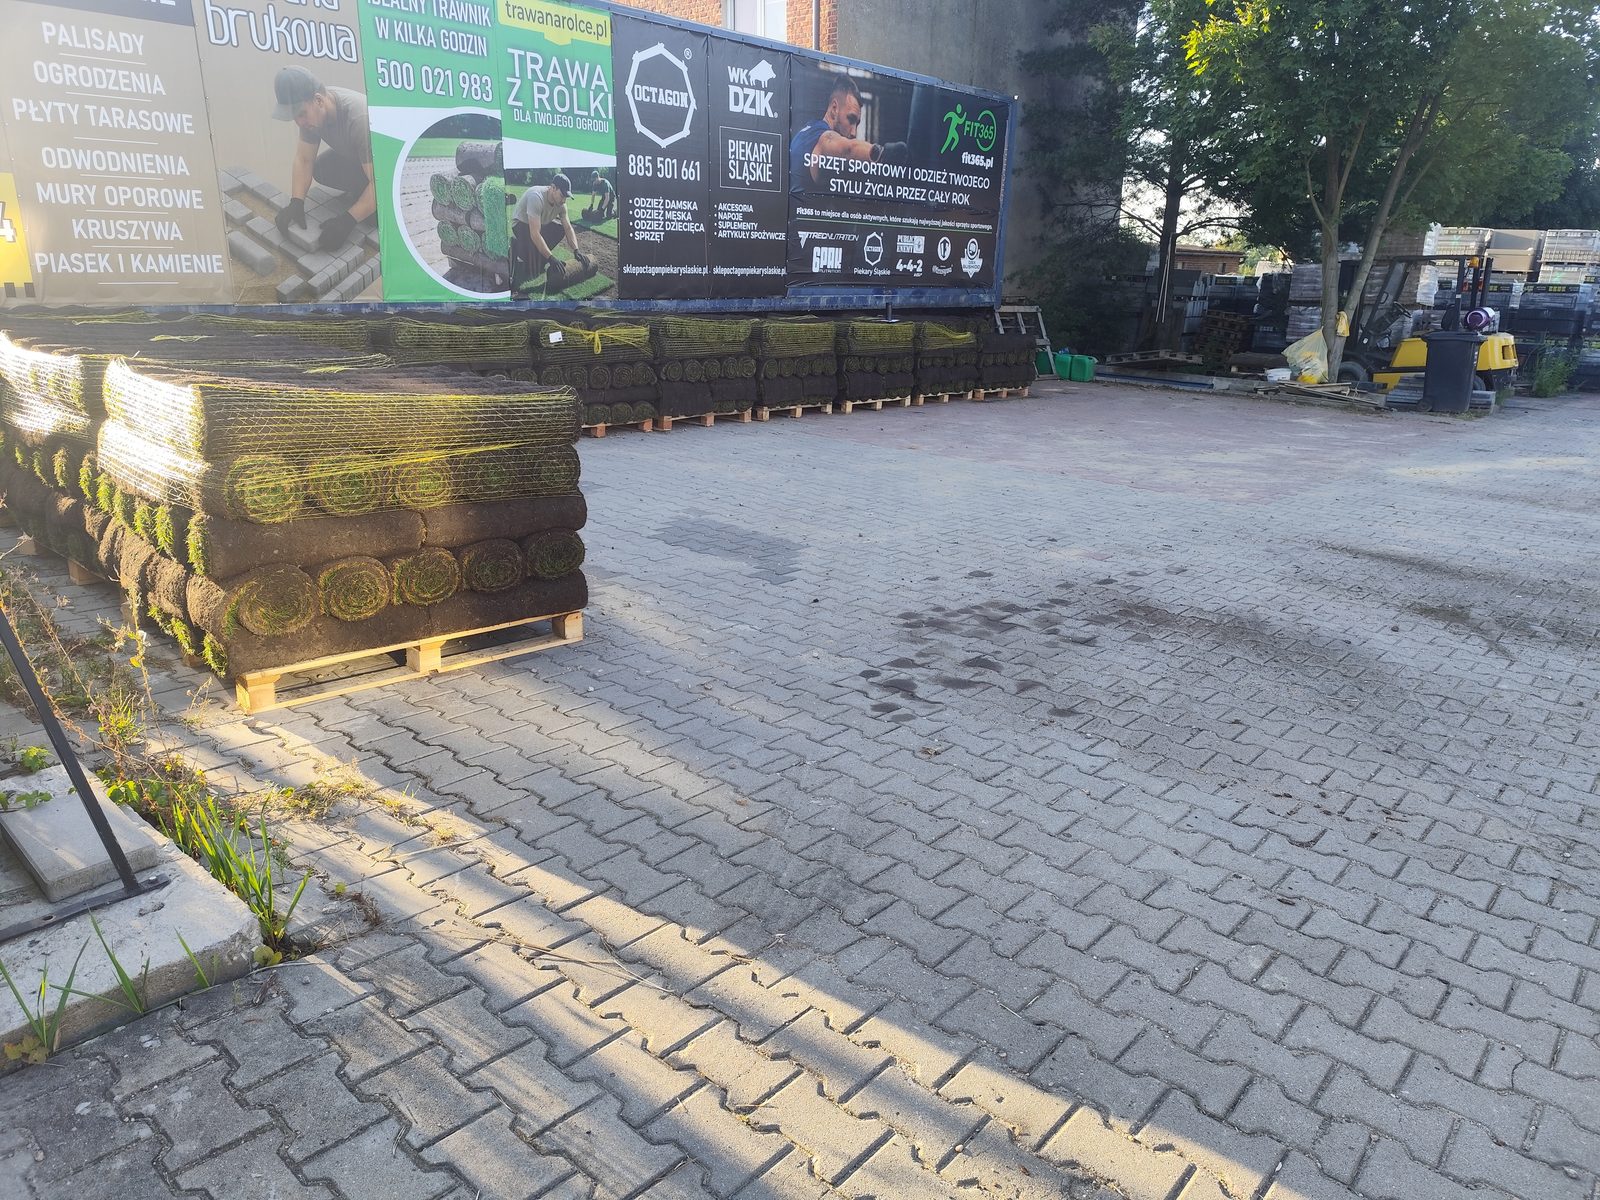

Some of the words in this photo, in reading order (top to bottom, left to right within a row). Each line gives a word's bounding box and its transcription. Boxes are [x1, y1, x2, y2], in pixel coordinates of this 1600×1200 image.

[432, 0, 491, 27] TRAWNIK
[505, 1, 607, 40] trawanarolce.pl
[41, 21, 144, 56] PALISADY
[203, 2, 358, 63] brukowa
[375, 16, 389, 40] W
[394, 20, 437, 48] KILKA
[440, 29, 488, 57] GODZIN
[33, 60, 167, 96] OGRODZENIA
[376, 57, 415, 91] 500
[420, 64, 454, 98] 021
[458, 70, 493, 103] 983
[506, 47, 609, 92] TRAWA
[728, 66, 749, 85] WK
[506, 77, 523, 106] Z
[533, 82, 613, 120] ROLKI
[634, 84, 689, 108] OCTAGON
[728, 84, 774, 118] DZIK
[12, 97, 79, 125] PŁYTY
[84, 104, 195, 135] TARASOWE
[513, 108, 532, 123] DLA
[534, 111, 574, 128] TWOJEGO
[576, 117, 609, 133] OGRODU
[964, 120, 994, 140] FIT365
[41, 147, 190, 176] ODWODNIENIA
[728, 139, 773, 163] PIEKARY
[961, 151, 994, 170] fit365.pl
[628, 154, 653, 177] 885
[656, 157, 678, 179] 501
[681, 160, 700, 181] 661
[728, 156, 773, 185] ŚLĄSKIE
[803, 153, 847, 174] SPRZĘT
[848, 158, 907, 180] SPORTOWY
[913, 169, 947, 184] ODZIEŻ
[948, 172, 990, 190] TWOJEGO
[36, 182, 97, 206] MURY
[104, 186, 204, 210] OPOROWE
[633, 197, 663, 209] ODZIEŻ
[665, 200, 698, 211] DAMSKA
[829, 178, 862, 195] STYLU
[864, 180, 894, 198] ŻYCIA
[896, 187, 926, 201] PRZEZ
[928, 189, 951, 203] CAŁY
[951, 192, 970, 206] ROK
[633, 208, 664, 220] ODZIEŻ
[665, 211, 692, 223] MĘSKA
[718, 203, 753, 213] AKCESORIA
[718, 212, 743, 221] NAPOJE
[821, 209, 841, 219] miejsce
[850, 211, 862, 219] osób
[889, 215, 902, 223] które
[72, 218, 184, 241] KRUSZYWA
[634, 219, 664, 231] ODZIEŻ
[665, 221, 705, 234] DZIECIĘCA
[634, 231, 665, 243] SPRZĘT
[717, 231, 749, 239] ARTYKUŁY
[750, 230, 786, 241] SPOŻYWCZE
[718, 222, 758, 231] SUPLEMENTY
[34, 253, 114, 273] PIASEK
[117, 254, 125, 273] I
[130, 253, 225, 274] KAMIENIE
[622, 264, 709, 276] sklepoctagonpiekaryslaskie.pl
[712, 266, 787, 277] sklepoctagonpiekaryslaskie.pl
[853, 267, 872, 277] Piekary
[873, 266, 891, 277] Śląskie
